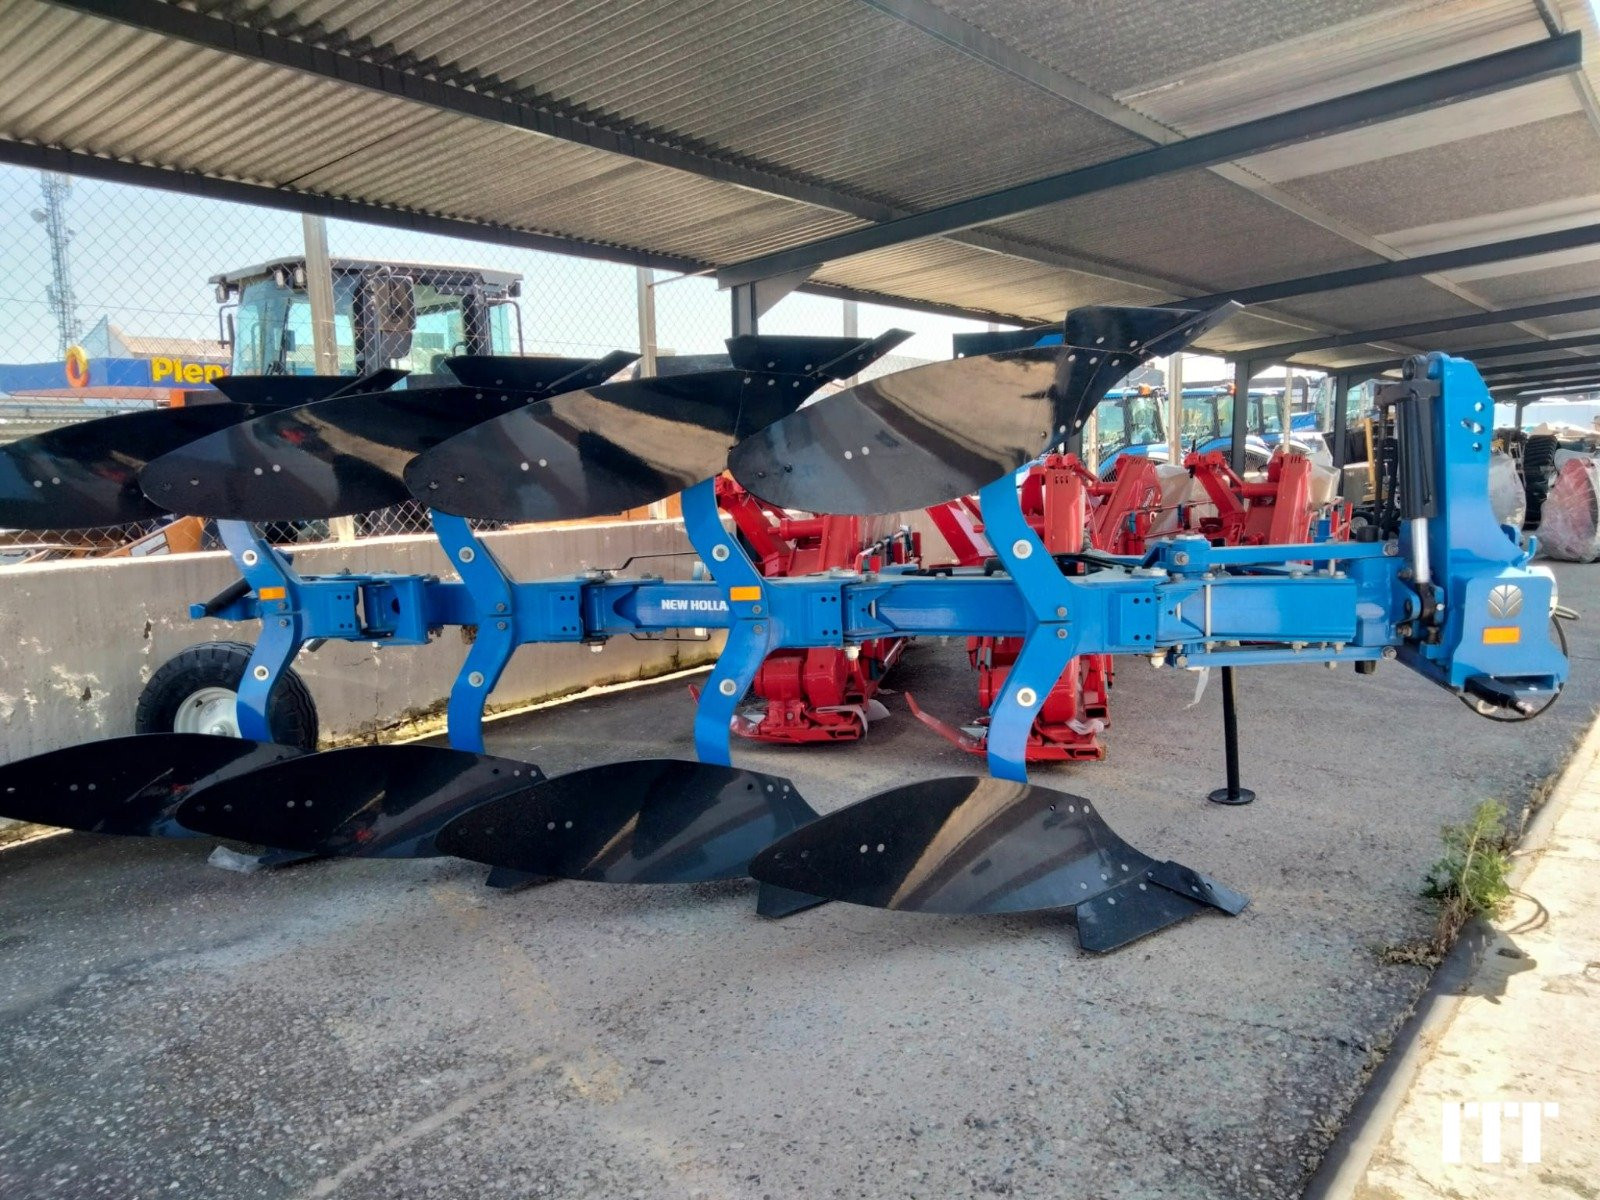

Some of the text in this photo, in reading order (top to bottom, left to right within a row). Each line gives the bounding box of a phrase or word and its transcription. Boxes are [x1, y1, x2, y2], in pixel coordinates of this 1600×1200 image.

[152, 356, 228, 384] Plen
[661, 600, 729, 611] NEW HOLLA
